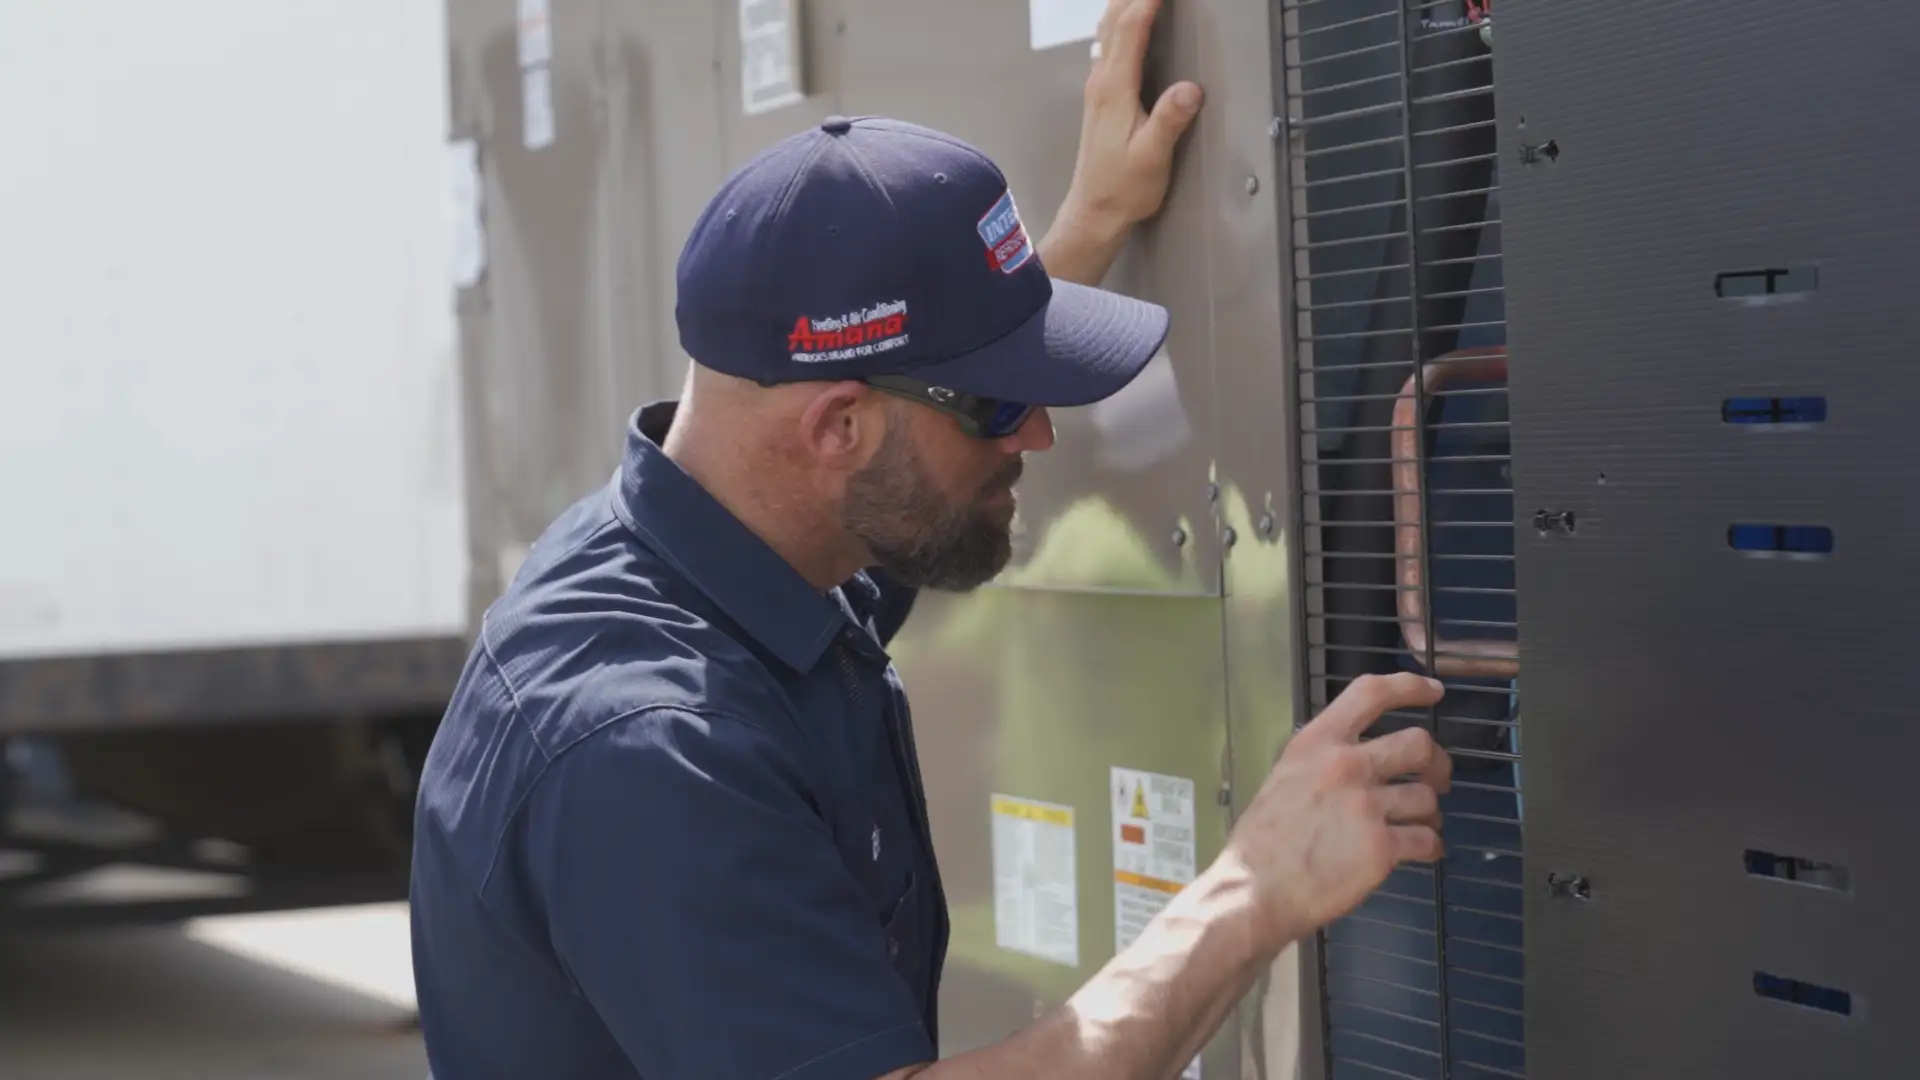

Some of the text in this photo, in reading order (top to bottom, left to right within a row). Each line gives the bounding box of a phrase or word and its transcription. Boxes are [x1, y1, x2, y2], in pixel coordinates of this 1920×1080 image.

[787, 315, 906, 352] Amana
[856, 344, 873, 356] FOR
[873, 333, 909, 353] COMFORT
